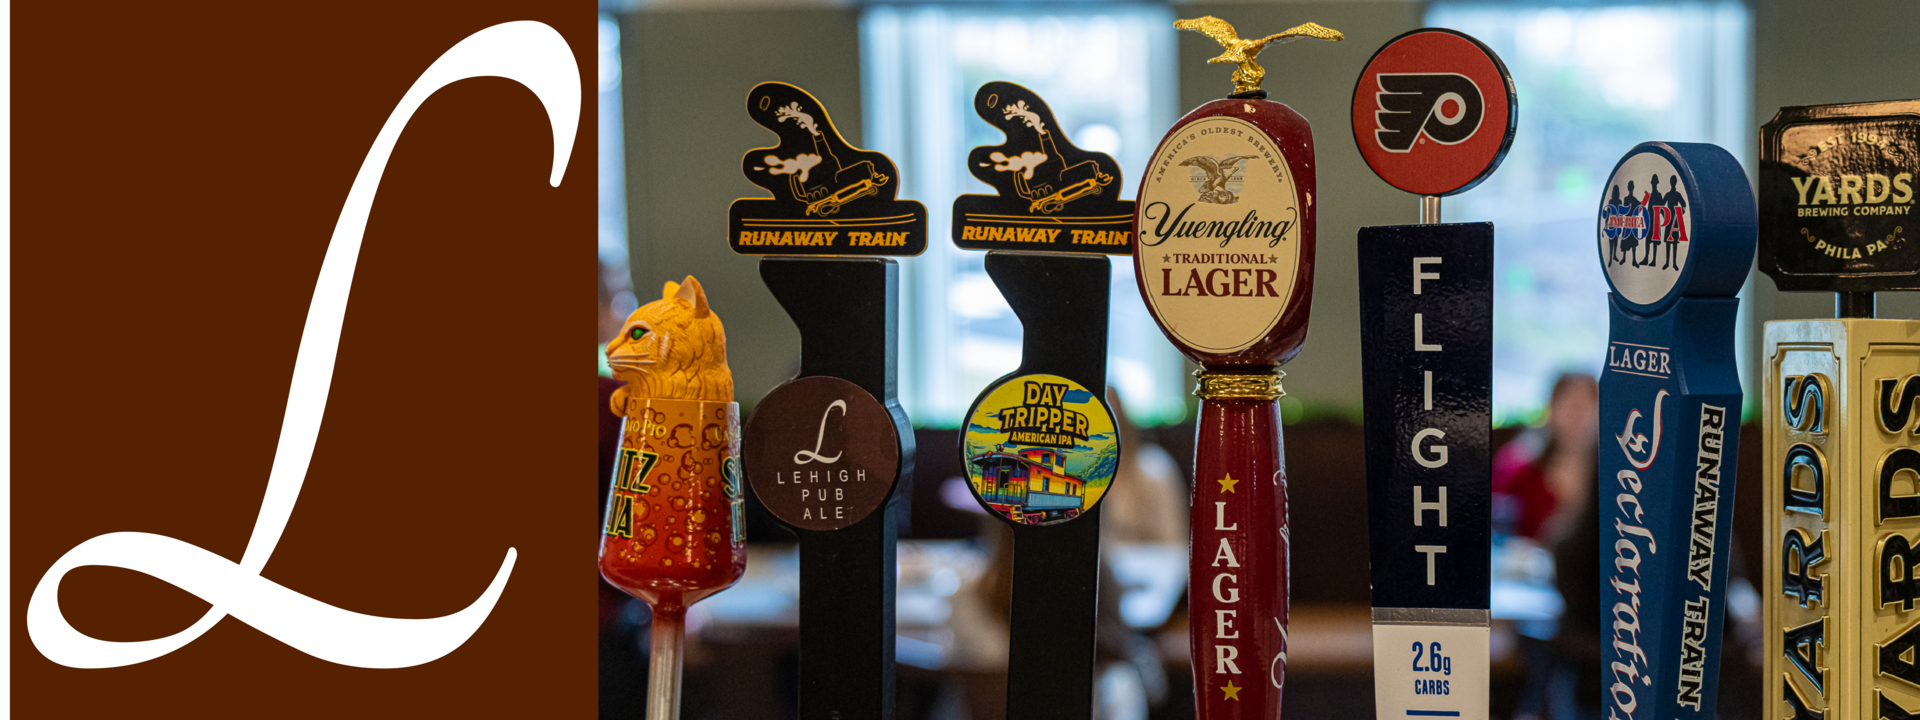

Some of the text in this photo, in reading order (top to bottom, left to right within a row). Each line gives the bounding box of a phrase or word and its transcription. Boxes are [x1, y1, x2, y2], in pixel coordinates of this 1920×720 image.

[1155, 133, 1196, 183] AMERICA'S
[1201, 127, 1244, 138] OLDEST
[1817, 134, 1843, 152] EST
[1791, 173, 1913, 206] YARDS
[1797, 205, 1911, 218] BREWING COMPANY
[738, 231, 910, 247] RUNAWAY TRAIN
[961, 225, 1132, 246] RUNAWAY TRAIN
[1172, 253, 1268, 265] TRADITIONAL
[1815, 239, 1888, 260] PHILA PA
[1161, 268, 1280, 298] LAGER
[1609, 345, 1671, 375] LAGER
[1025, 381, 1068, 407] DAY
[794, 399, 847, 465] L
[1001, 406, 1088, 437] TRIPPER
[1411, 256, 1449, 586] FLIGHT
[1011, 431, 1073, 446] AMERICAN IPA
[776, 469, 866, 484] LEHIGH
[802, 488, 844, 501] PUB
[803, 506, 844, 520] ALE
[1608, 388, 1670, 720] Declaratio
[1677, 403, 1726, 712] RUNAWAY TRAIN
[1211, 501, 1242, 674] LAGER
[1412, 641, 1451, 676] 2.6g
[1415, 679, 1450, 695] CARBS
